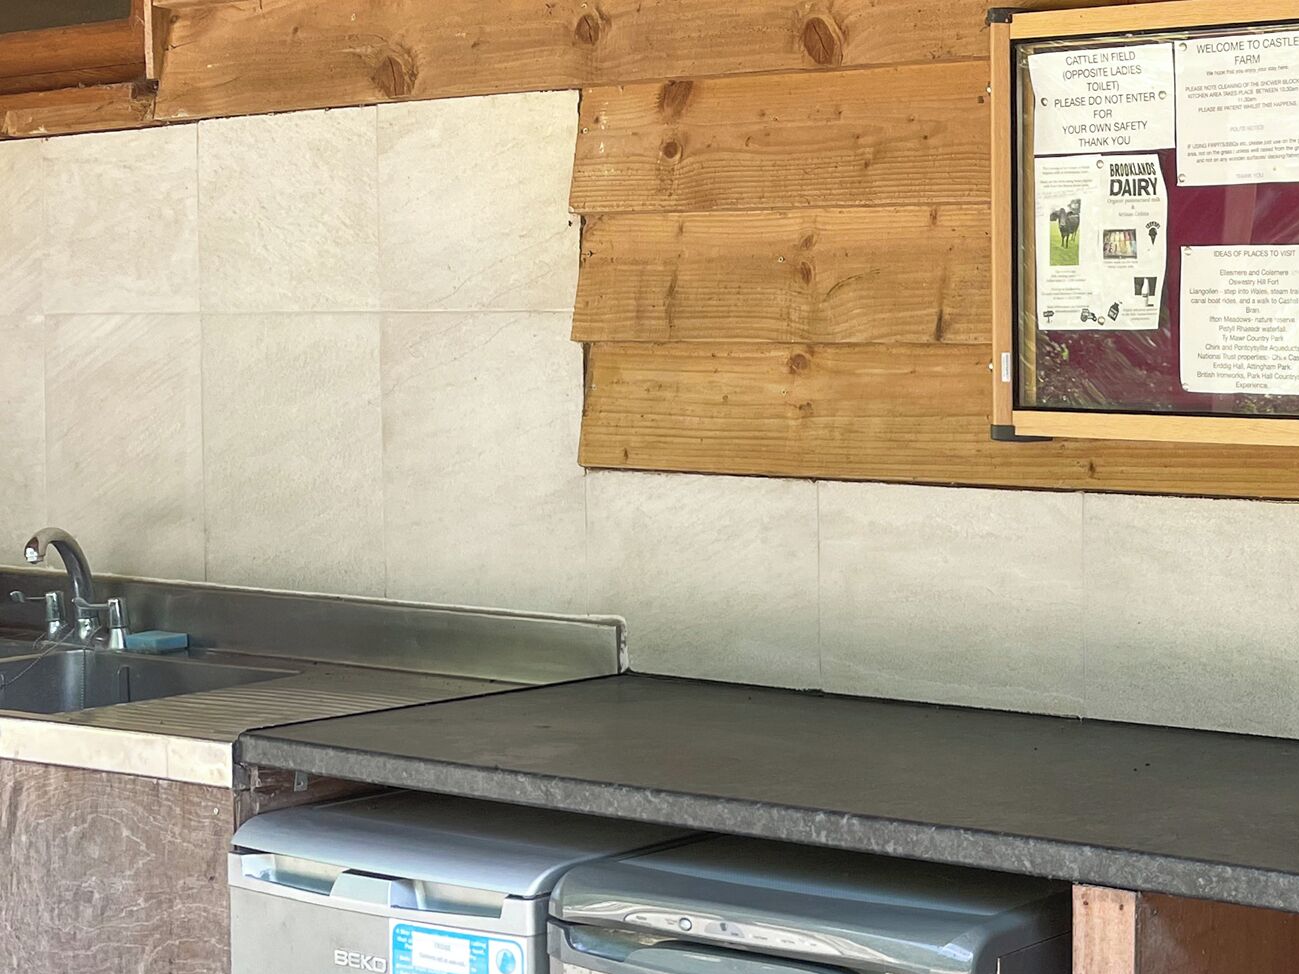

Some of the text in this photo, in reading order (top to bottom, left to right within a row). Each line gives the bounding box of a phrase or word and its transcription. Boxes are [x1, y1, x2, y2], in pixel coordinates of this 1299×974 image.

[1197, 37, 1299, 54] WELCOME TO CASTLE
[1066, 51, 1135, 65] CATTLE IN FIELD
[1235, 55, 1260, 65] FARM
[1063, 65, 1142, 80] (OPPOSITE LADIES
[1087, 81, 1119, 91] TOILET)
[1055, 92, 1155, 108] PLEASE DO NOT ENTER
[1094, 109, 1112, 119] FOR
[1063, 121, 1147, 134] YOUR OWN SAFETY
[1079, 136, 1130, 147] THANK YOU
[1110, 162, 1156, 177] BROOKLANDS
[1110, 177, 1157, 196] DAIRY
[1247, 363, 1275, 371] Attingham
[334, 949, 387, 974] BEKO
